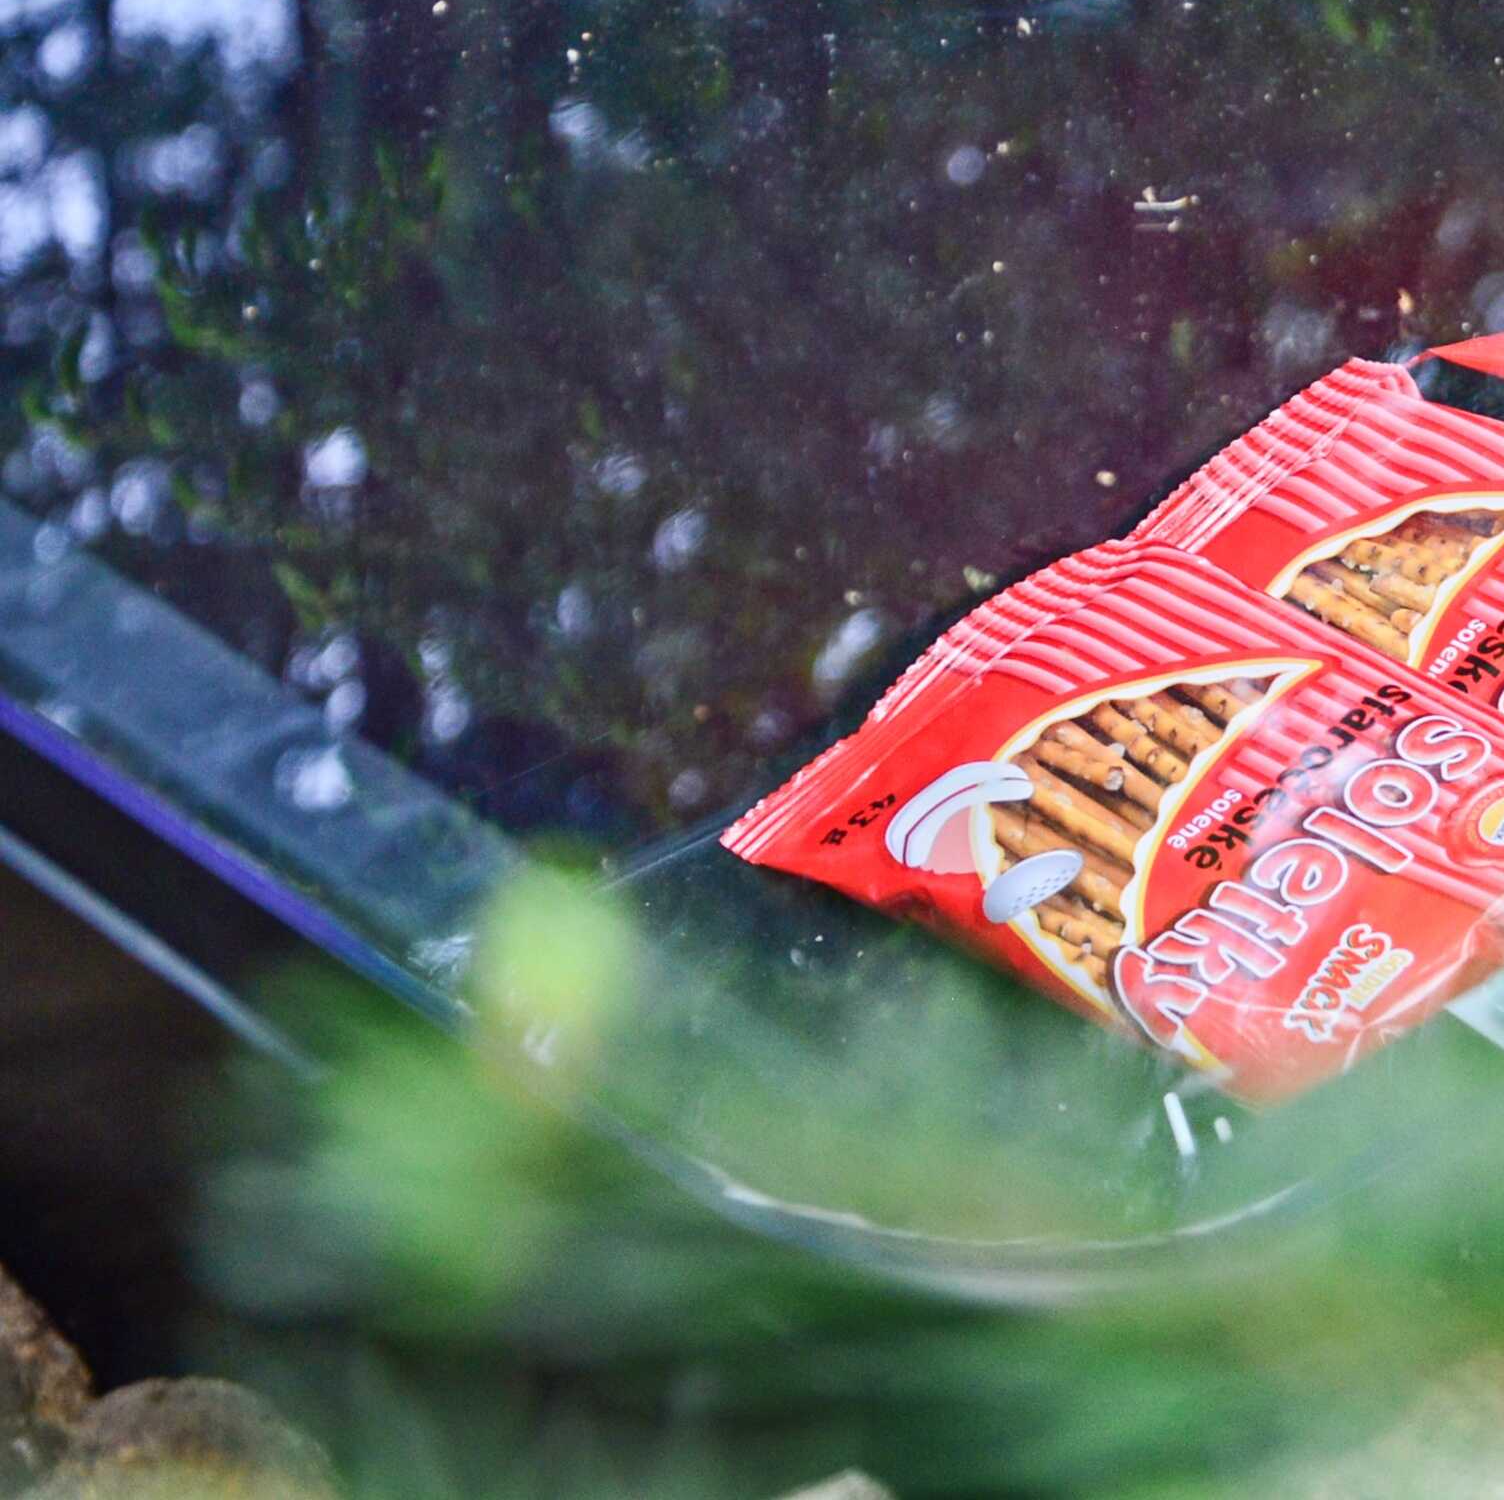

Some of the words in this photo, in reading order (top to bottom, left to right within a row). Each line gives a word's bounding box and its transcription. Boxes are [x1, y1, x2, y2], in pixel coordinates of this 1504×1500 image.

[1428, 619, 1488, 680] solen
[1165, 789, 1243, 849] solené
[1184, 684, 1412, 871] staročeské
[1114, 715, 1491, 1050] soletky
[1286, 925, 1391, 1037] SNACK
